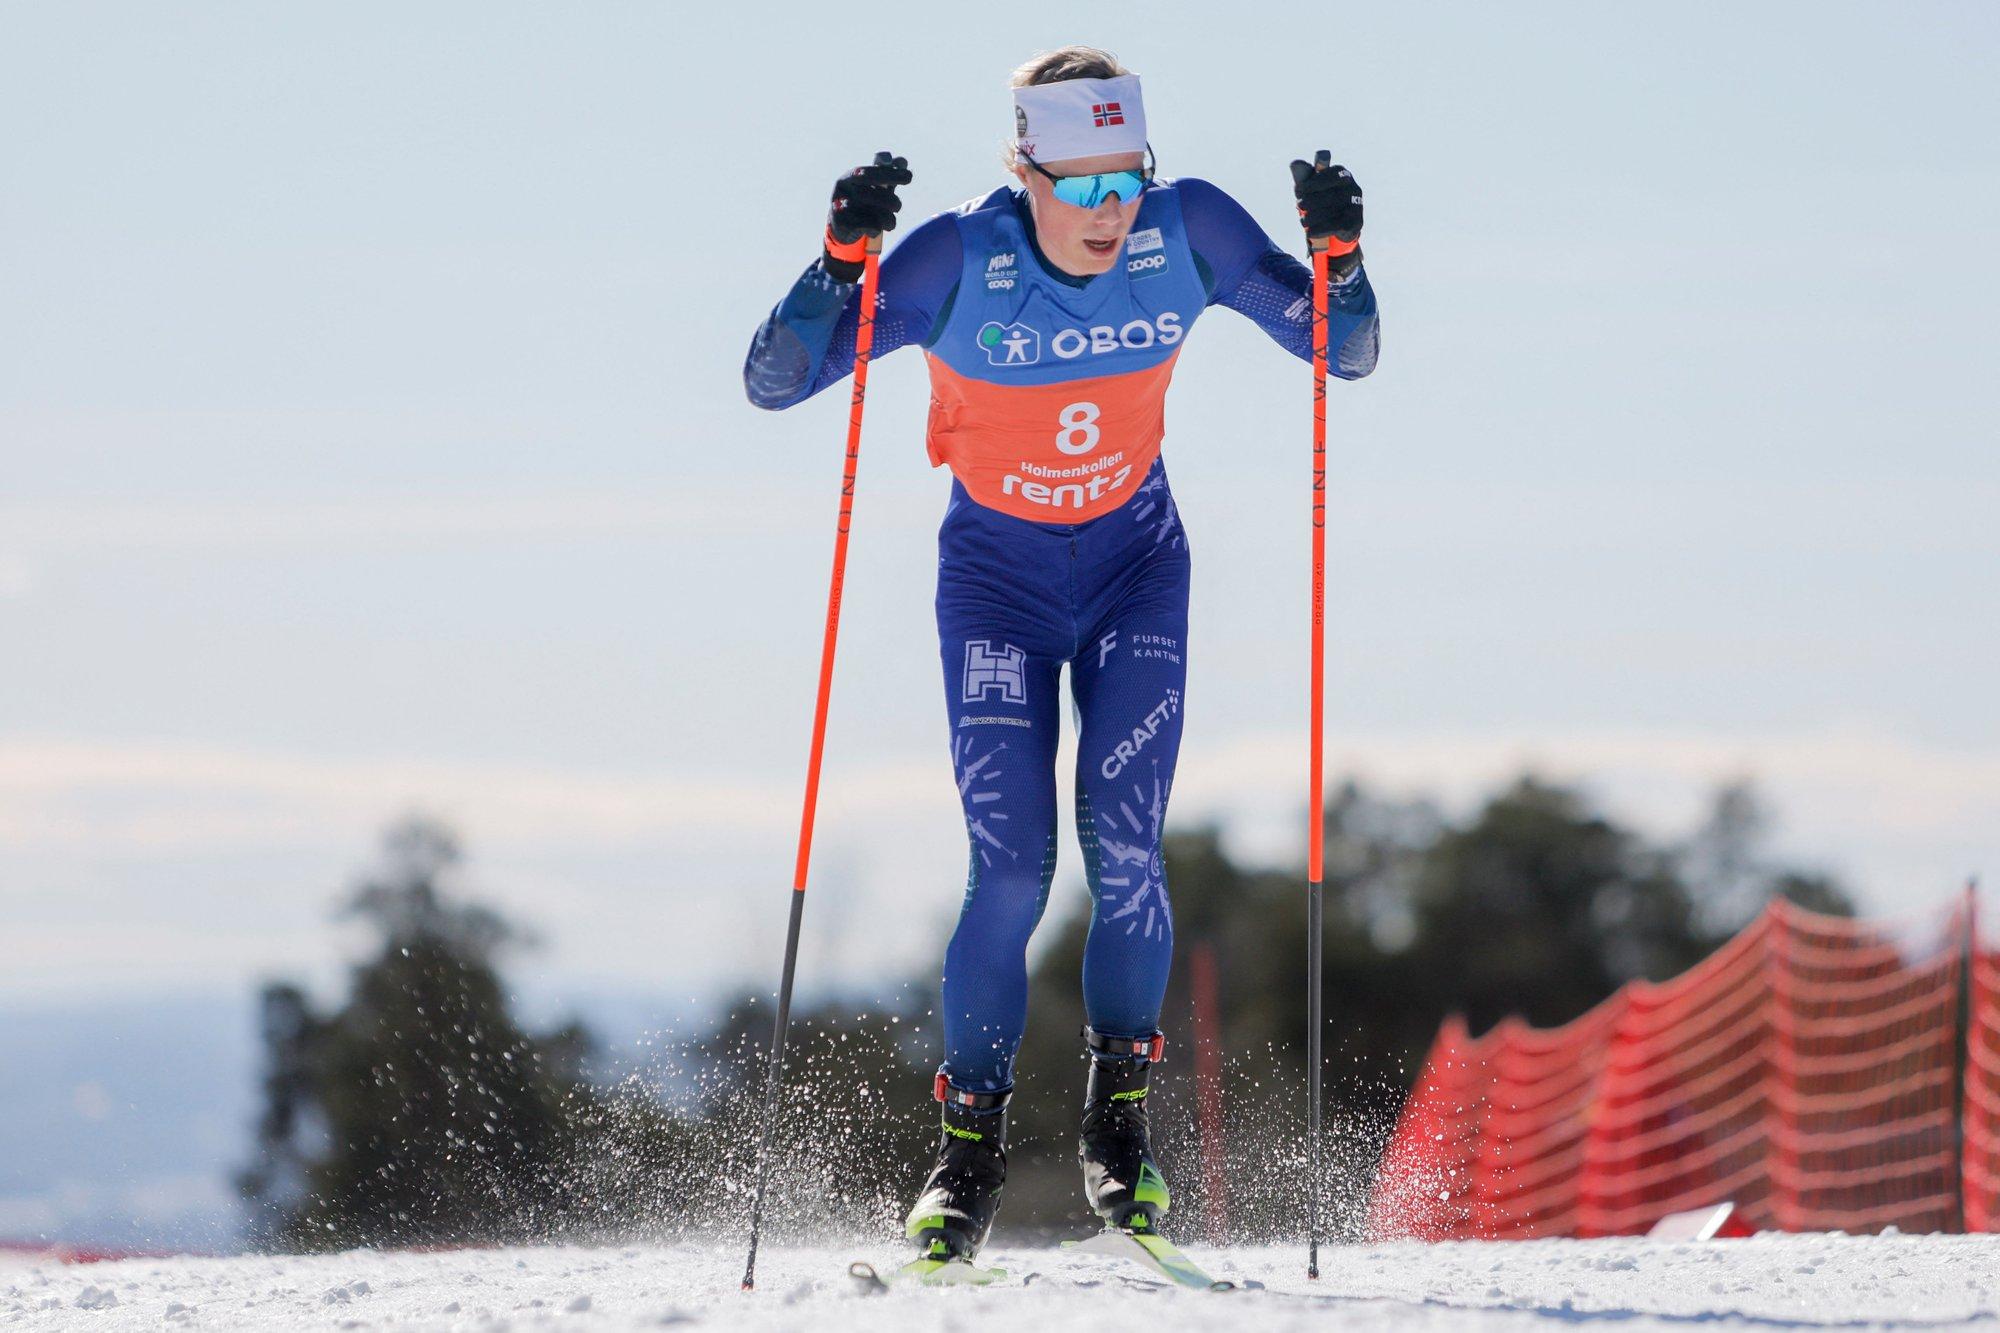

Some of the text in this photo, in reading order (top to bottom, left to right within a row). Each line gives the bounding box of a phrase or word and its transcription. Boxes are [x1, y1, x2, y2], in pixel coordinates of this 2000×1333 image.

[1128, 255, 1165, 272] coop
[988, 279, 1014, 290] coop
[1051, 312, 1183, 358] OBOS
[1055, 402, 1101, 455] 8
[1020, 451, 1123, 478] Holmenkollen
[1133, 635, 1177, 649] FURSET
[1134, 649, 1180, 664] KANTINE
[1101, 699, 1170, 780] CRAFT
